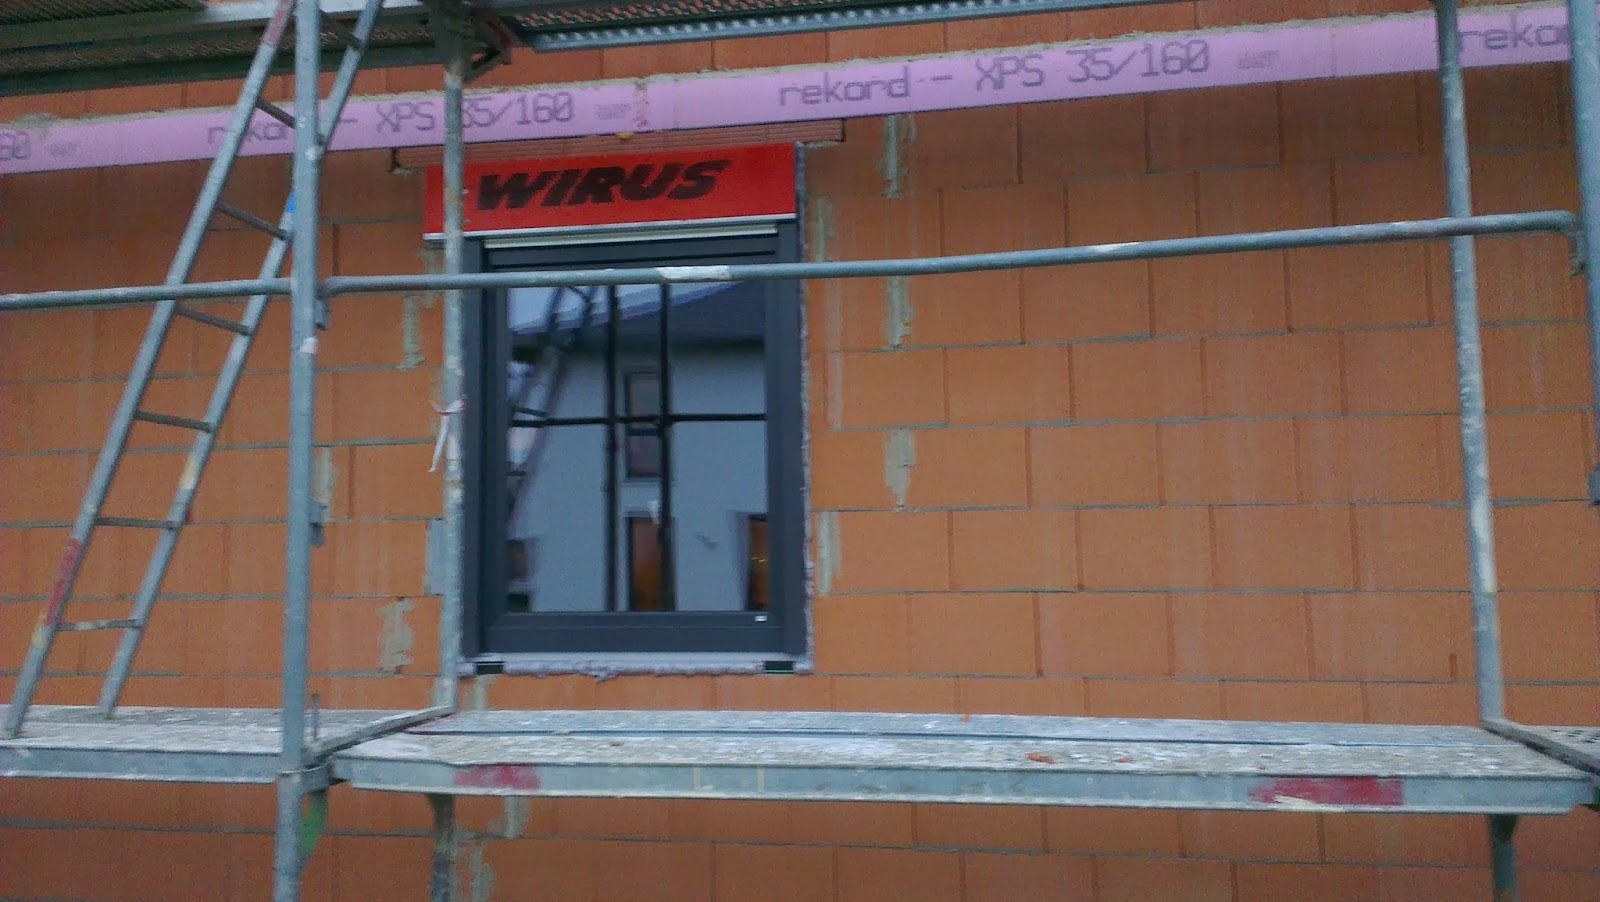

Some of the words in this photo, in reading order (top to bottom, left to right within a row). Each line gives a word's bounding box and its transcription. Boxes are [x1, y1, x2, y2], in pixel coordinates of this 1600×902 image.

[779, 64, 910, 106] rekord
[975, 53, 1046, 91] XPS
[1066, 38, 1210, 82] 35/160
[376, 101, 436, 133] XPS
[477, 158, 733, 211] WIRUS
